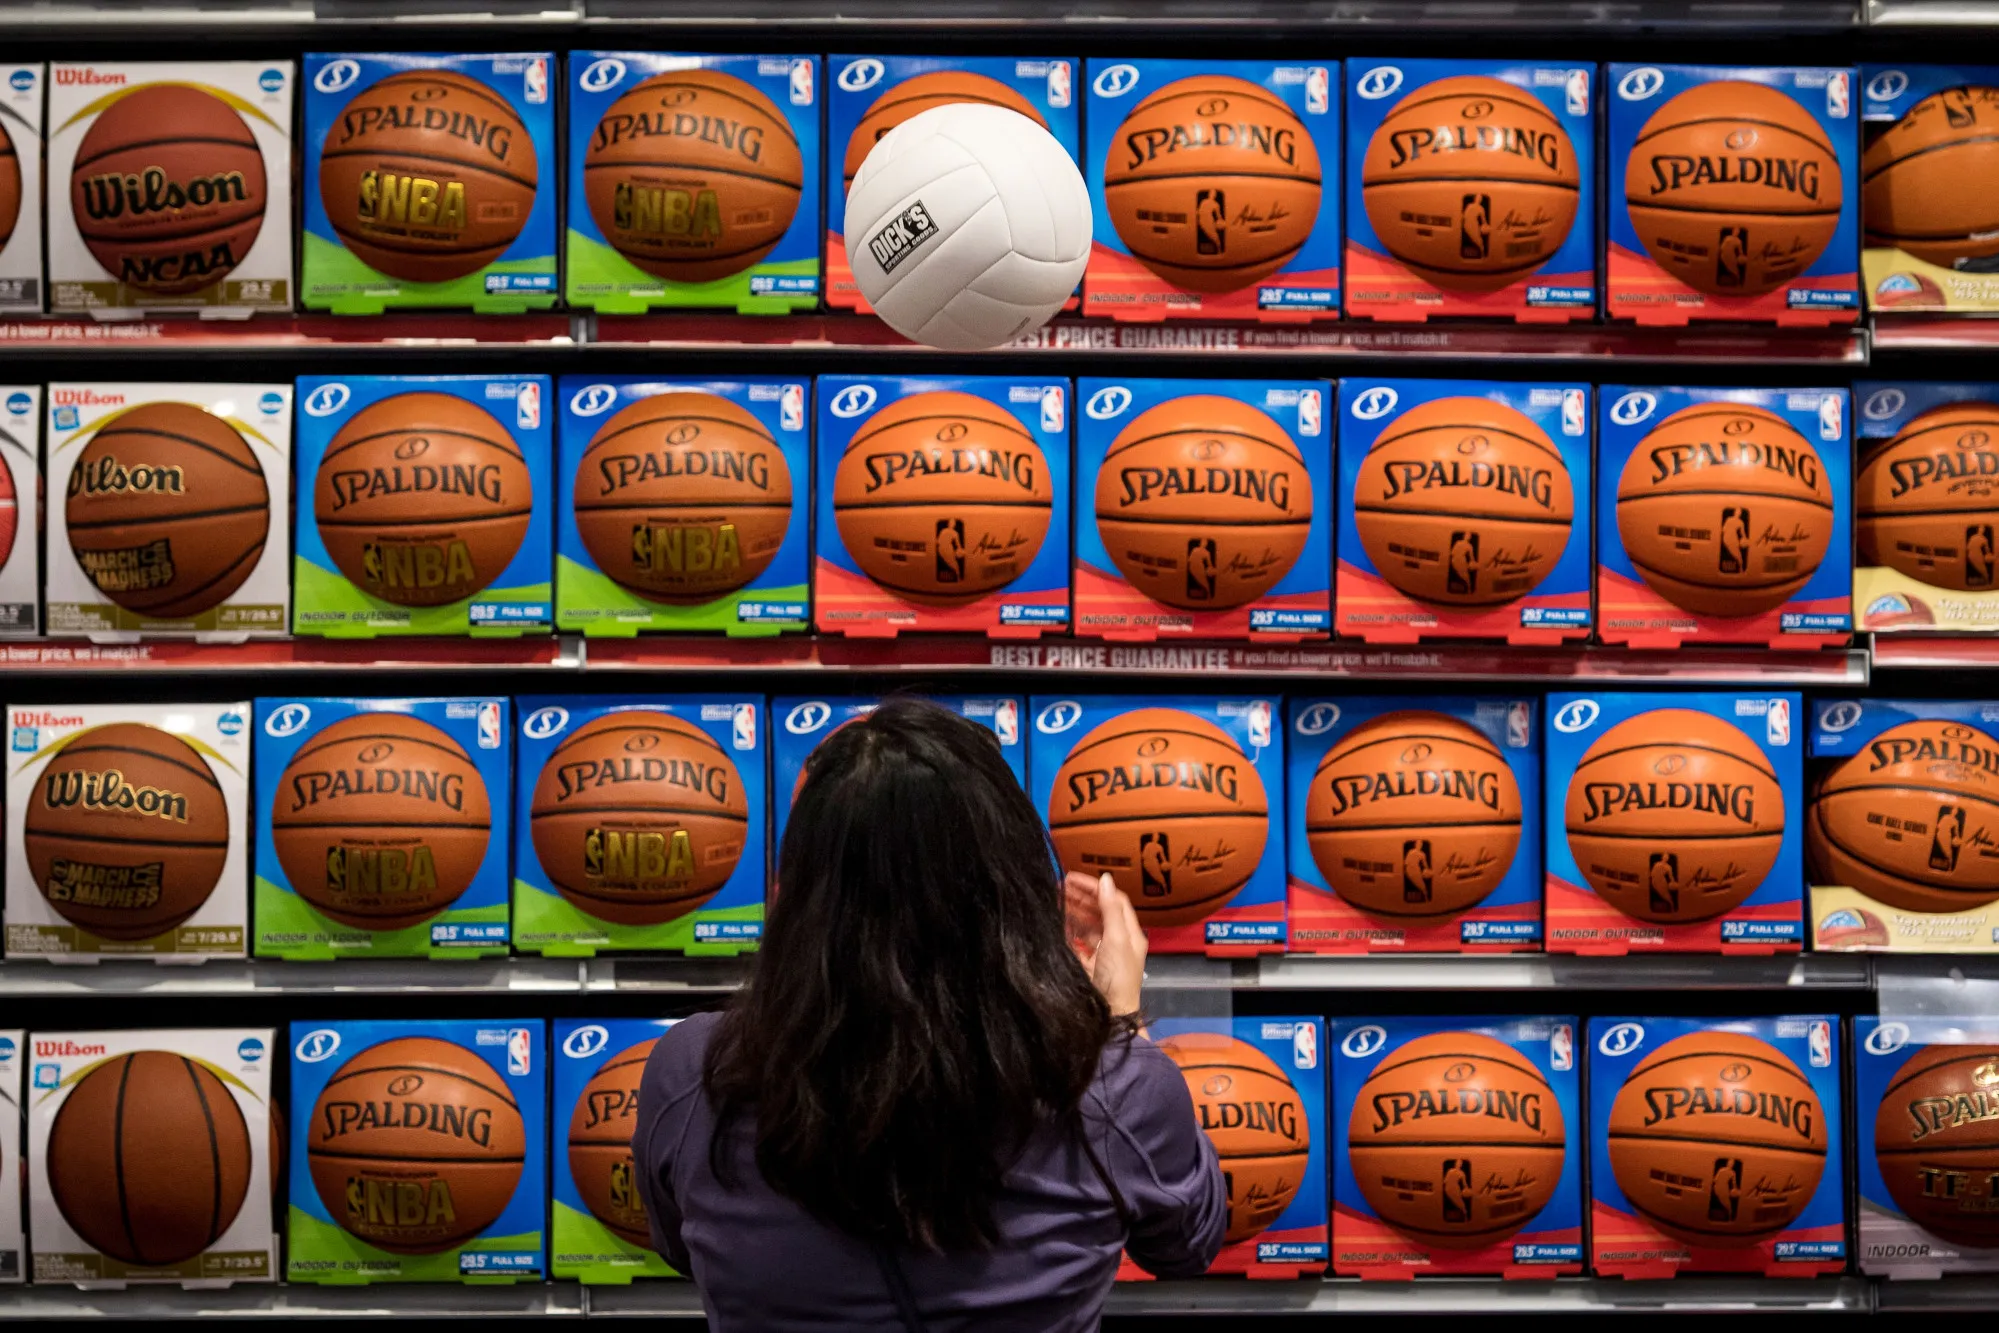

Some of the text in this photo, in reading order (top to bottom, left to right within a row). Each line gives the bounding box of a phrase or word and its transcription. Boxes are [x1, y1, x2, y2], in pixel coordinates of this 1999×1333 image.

[55, 69, 126, 85] Wilson
[340, 105, 513, 161] SPALDING
[594, 112, 764, 162] SPALDING
[1127, 123, 1296, 171] SPALDING
[1390, 126, 1559, 171] SPALDING
[81, 169, 246, 219] Wilson
[1650, 155, 1819, 200] SPALDING
[380, 174, 466, 228] NBA
[635, 186, 721, 238] NBA
[871, 205, 929, 265] DICK'S
[885, 226, 934, 269] SPORTING GOODS
[121, 243, 236, 281] NCAA
[1016, 327, 1239, 349] EST PRICE GUARANTEE
[54, 390, 125, 405] Wilson
[332, 465, 501, 511] SPALDING
[600, 452, 769, 496] SPALDING
[865, 449, 1034, 494] SPALDING
[1119, 467, 1290, 511] SPALDING
[1384, 460, 1553, 509] SPALDING
[1650, 442, 1817, 491] SPALDING
[84, 553, 138, 569] MARCH
[383, 541, 475, 589] NBA
[655, 524, 740, 572] NBA
[95, 561, 173, 586] MADNESS
[992, 646, 1229, 669] BEST PRICE GUARANTEE
[14, 712, 84, 727] Wilson
[46, 771, 187, 822] Wilson
[291, 769, 464, 813] SPALDING
[556, 757, 727, 804] SPALDING
[1068, 762, 1238, 813] SPALDING
[1330, 770, 1499, 817] SPALDING
[1584, 783, 1754, 824] SPALDING
[62, 862, 130, 886] MARCH
[352, 847, 436, 893] NBA
[605, 830, 694, 879] NBA
[72, 883, 159, 907] MADNESS
[35, 1041, 105, 1057] Wilson
[322, 1102, 492, 1148] SPALDING
[1199, 1101, 1297, 1141] LDING
[1372, 1089, 1541, 1134] SPALDING
[1643, 1087, 1813, 1140] SPALDING
[1908, 1092, 1999, 1141] SPAL
[368, 1180, 456, 1227] NBA
[1868, 1244, 1930, 1257] INDOOR
